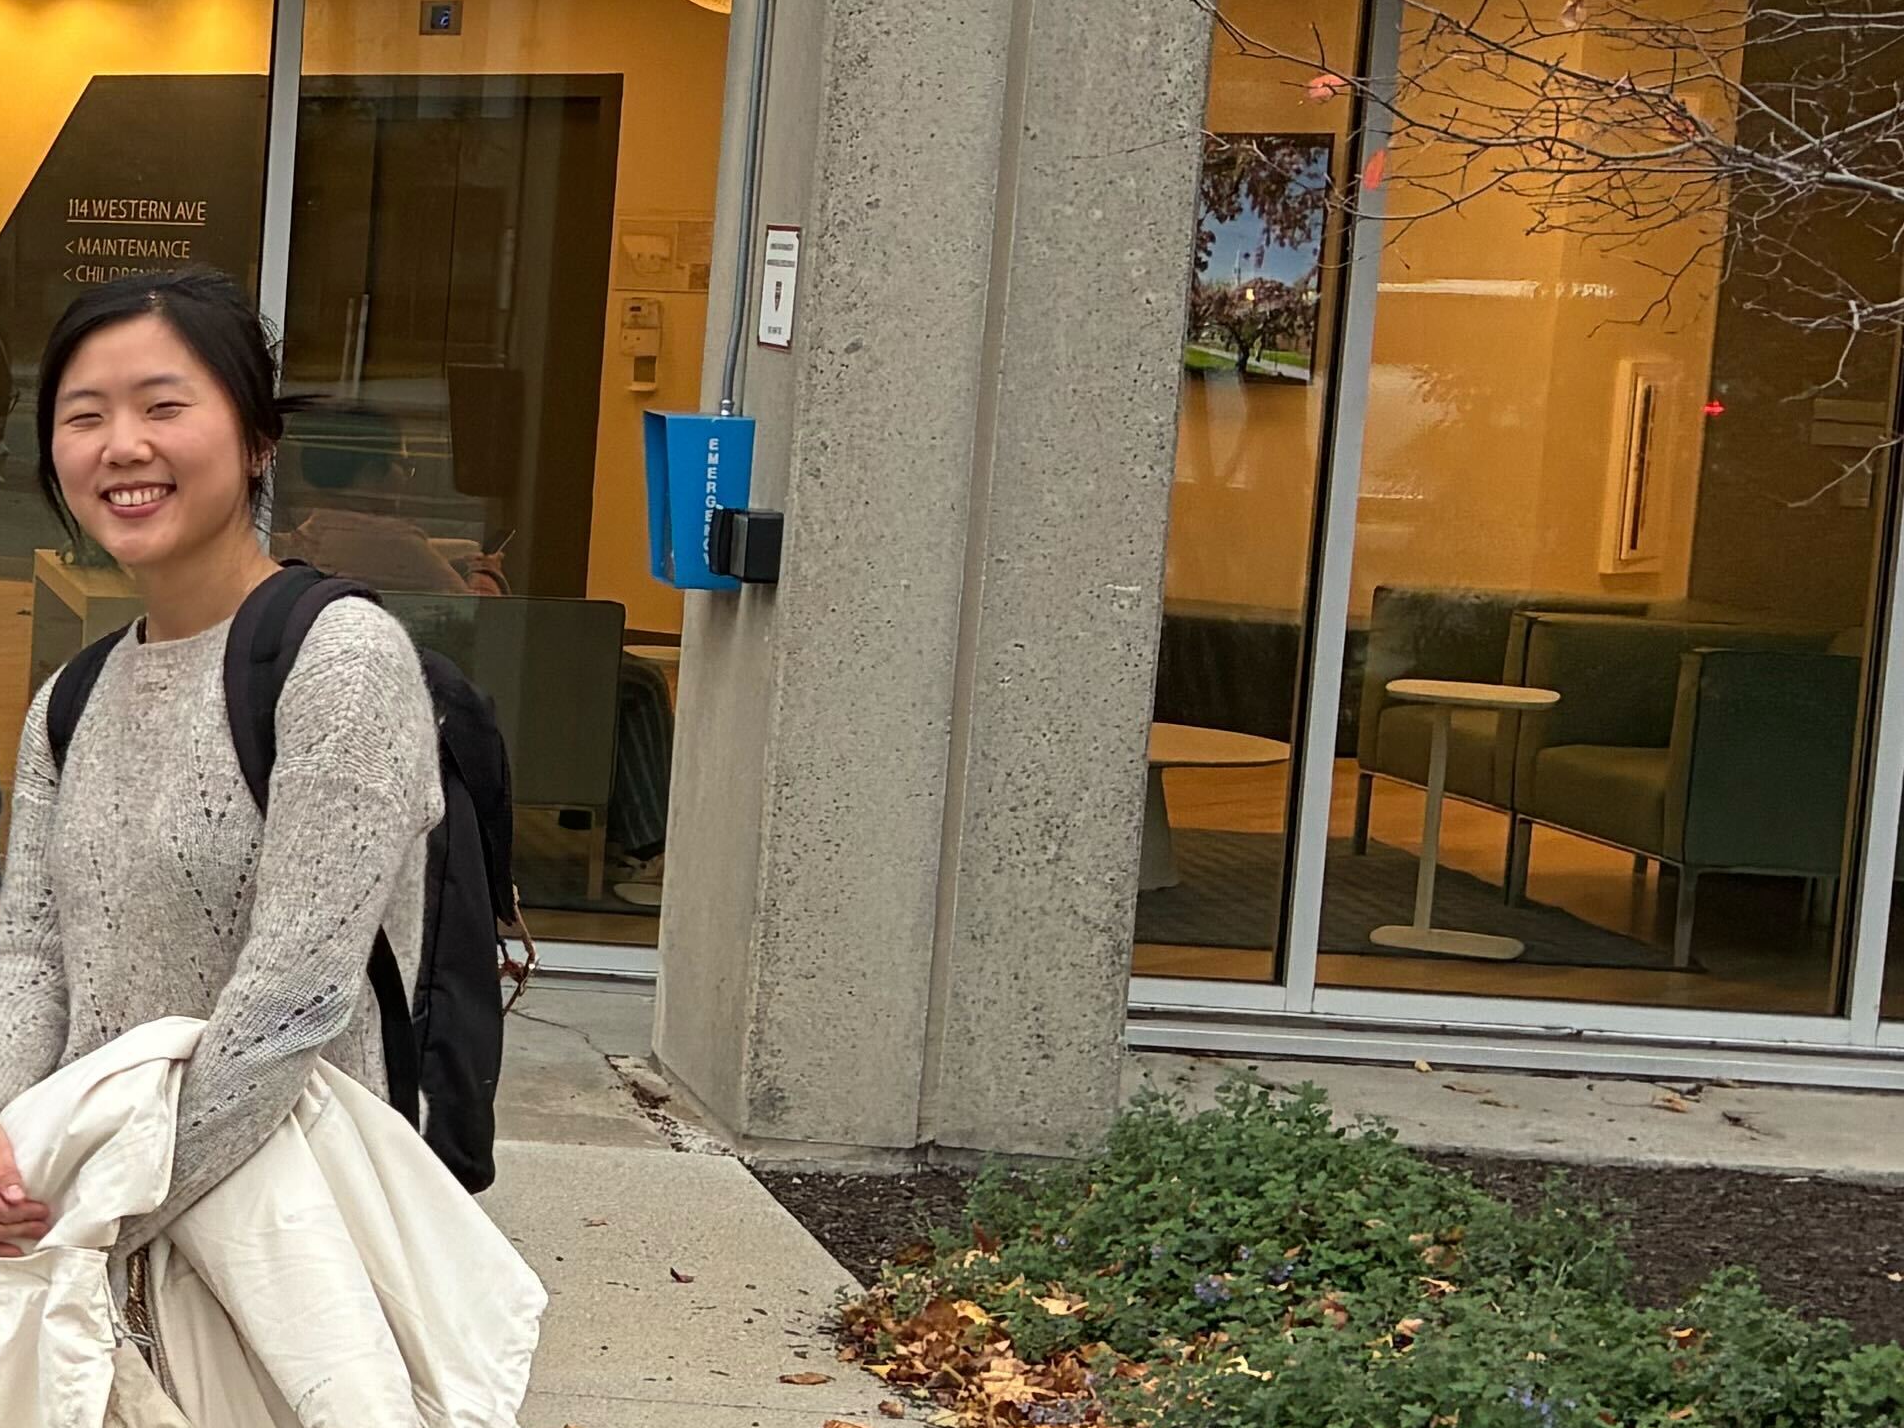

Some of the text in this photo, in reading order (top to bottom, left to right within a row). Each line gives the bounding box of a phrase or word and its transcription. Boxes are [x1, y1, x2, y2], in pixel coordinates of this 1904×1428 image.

[68, 198, 207, 221] 114 WESTERN AVE
[77, 236, 191, 259] MAINTENANCE
